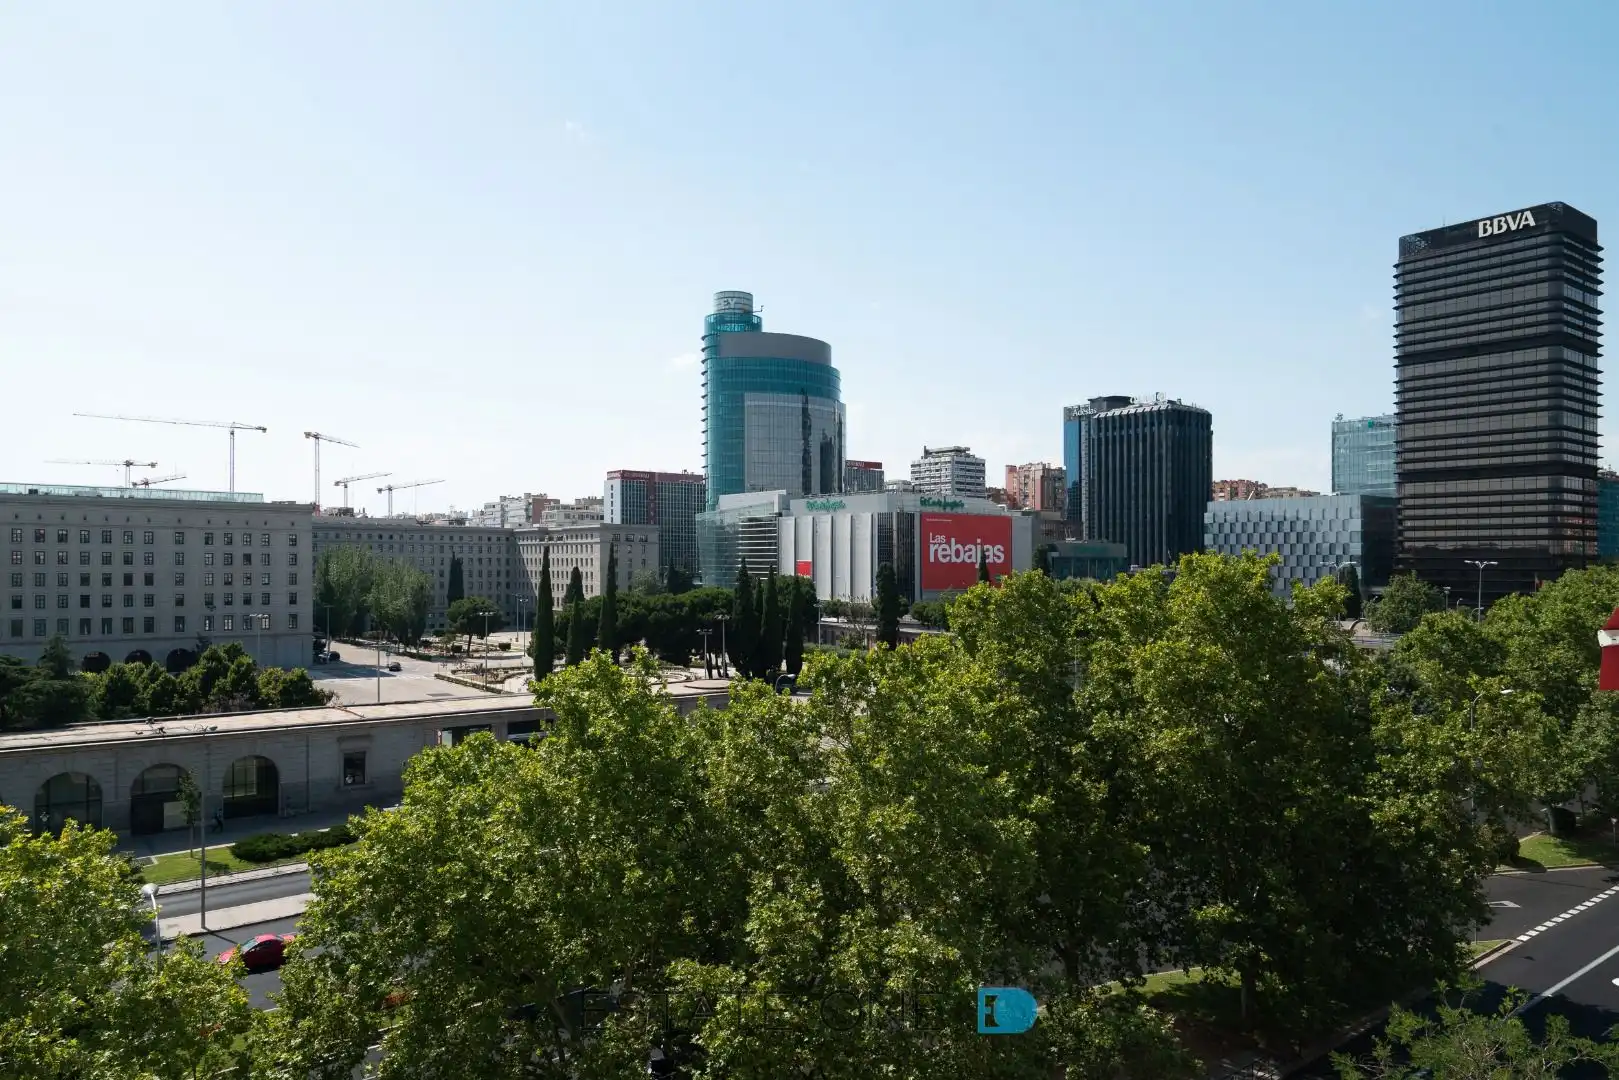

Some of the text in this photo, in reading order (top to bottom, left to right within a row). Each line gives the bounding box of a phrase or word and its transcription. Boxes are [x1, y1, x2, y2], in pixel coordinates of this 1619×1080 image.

[1478, 210, 1536, 238] BBVA
[722, 298, 737, 309] EY
[929, 532, 946, 543] Las
[929, 538, 1005, 569] rebajas
